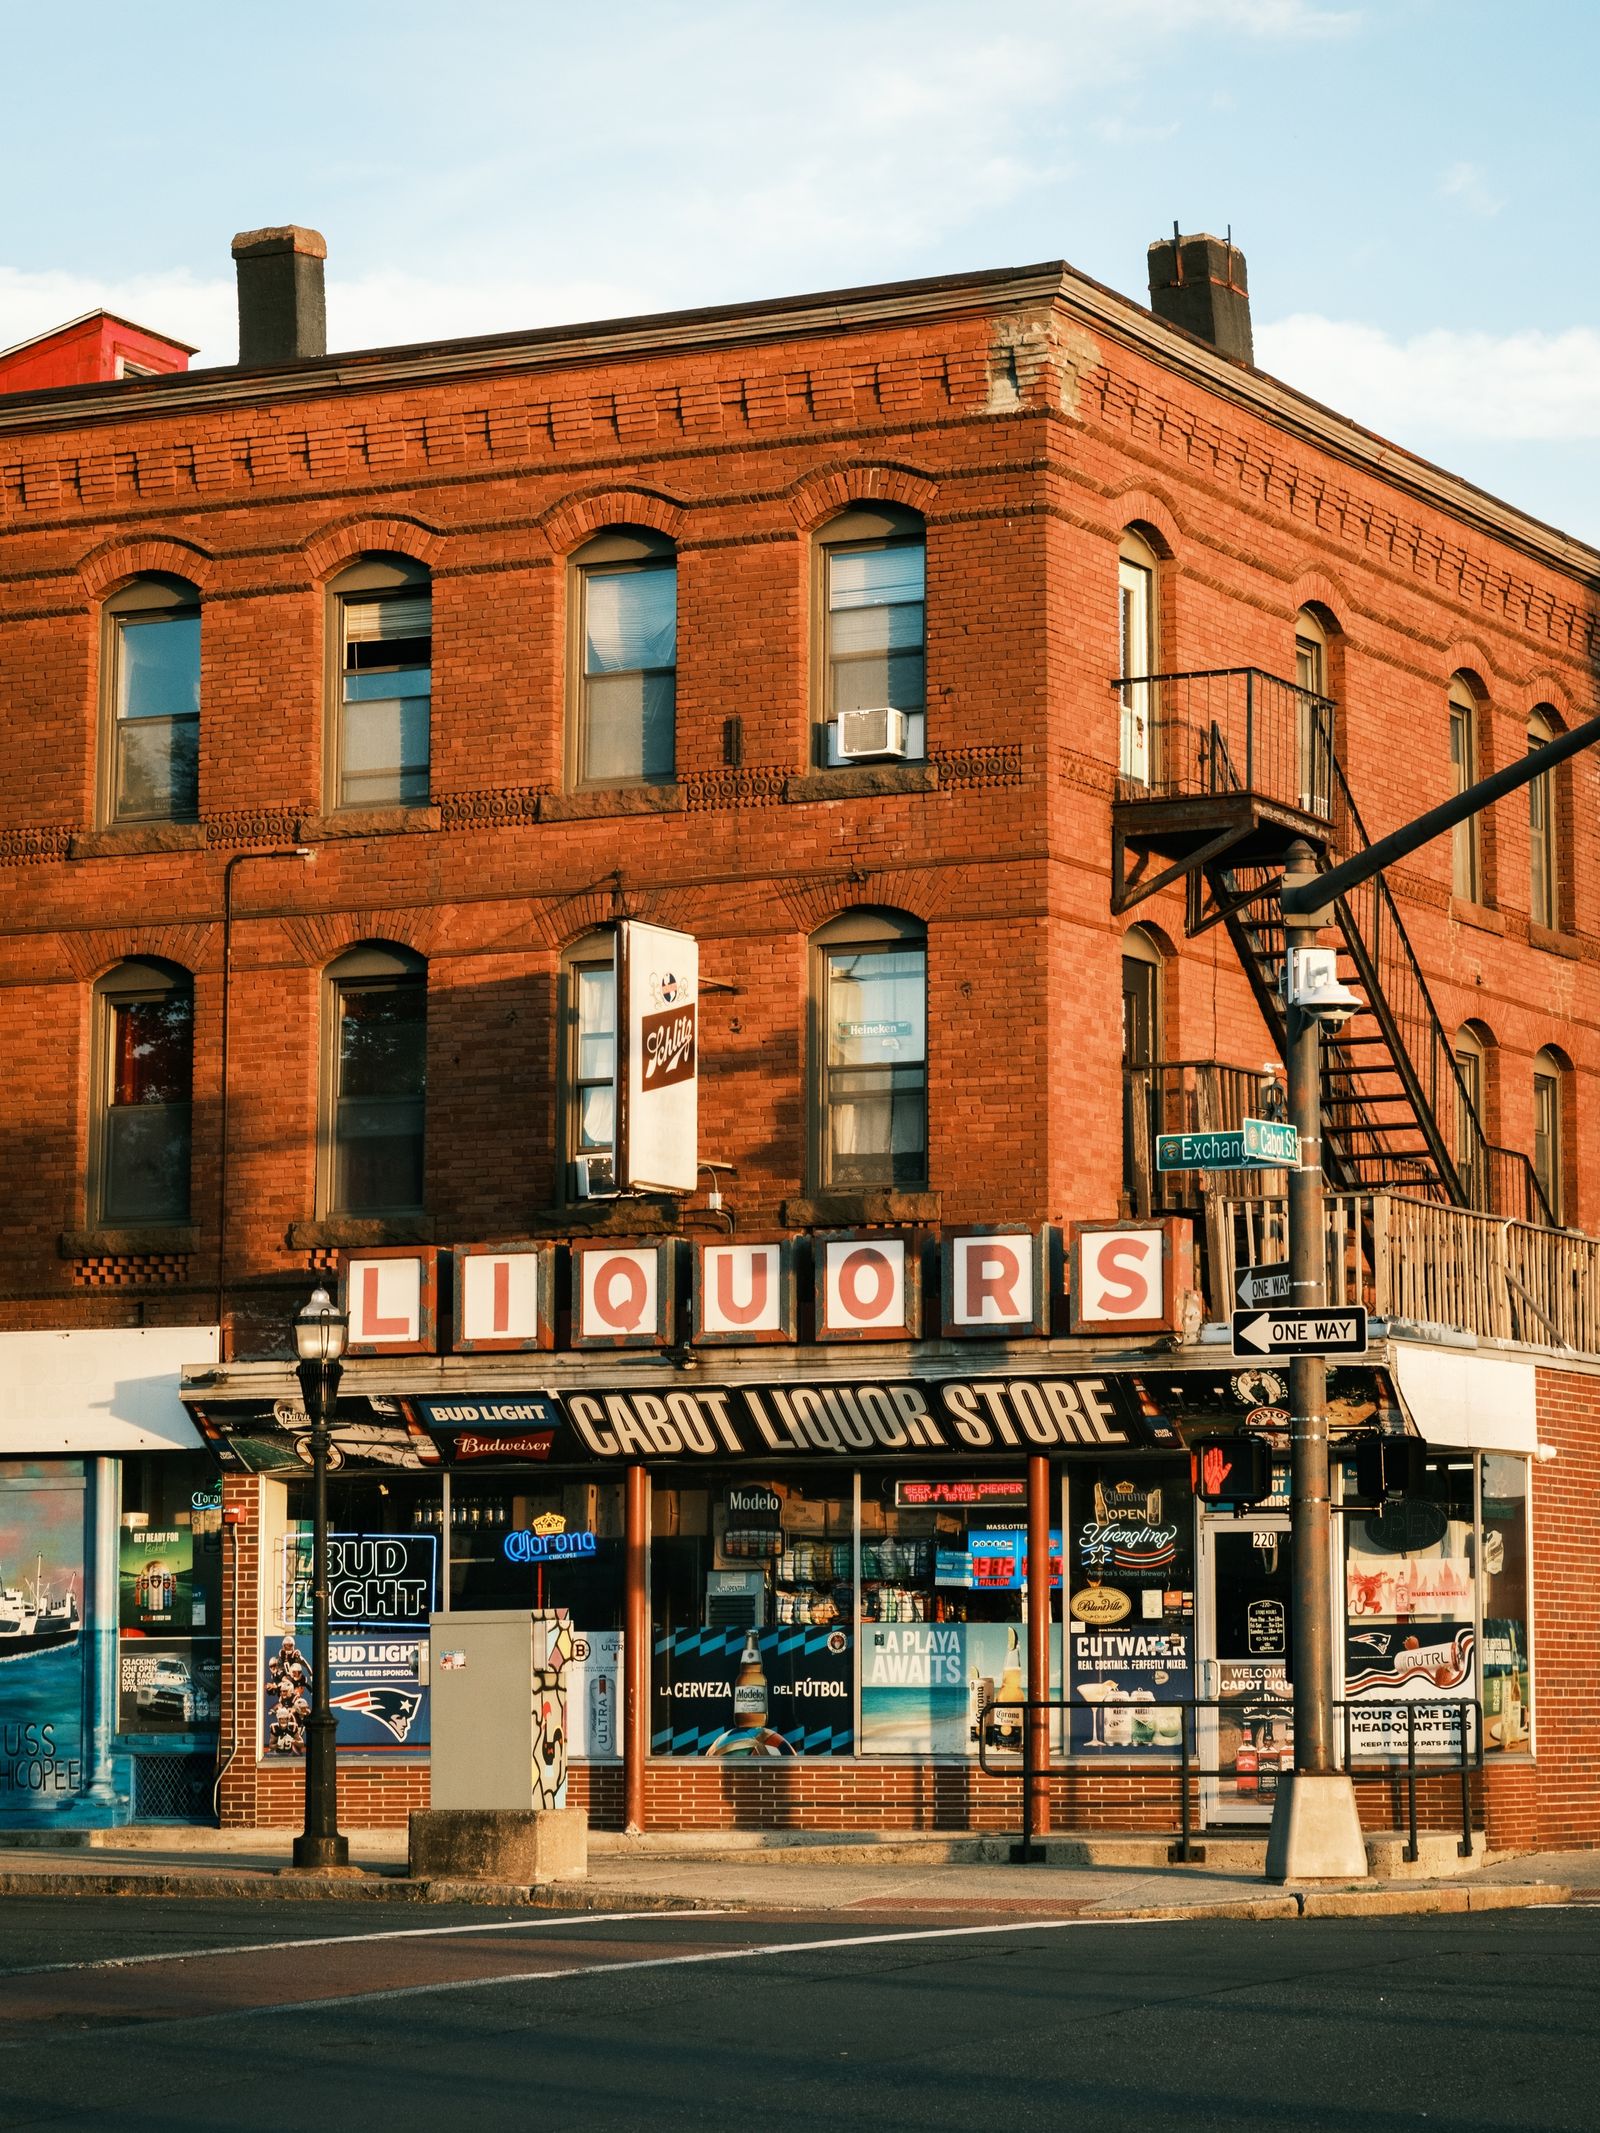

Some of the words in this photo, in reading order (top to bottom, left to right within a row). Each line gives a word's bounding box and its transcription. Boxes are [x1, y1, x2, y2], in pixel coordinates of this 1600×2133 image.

[850, 1024, 897, 1034] Heineken
[645, 1016, 692, 1079] Schlitz
[1260, 1125, 1284, 1157] Cabot
[1285, 1130, 1296, 1158] St
[362, 1238, 1149, 1336] LIQUORS
[1252, 1279, 1269, 1298] ONE
[1272, 1277, 1289, 1295] WAY
[1272, 1323, 1307, 1341] ONE
[1315, 1322, 1351, 1340] WAY
[1230, 1376, 1249, 1405] BOSTON
[1266, 1370, 1288, 1398] CELTICS
[430, 1406, 480, 1421] BUD
[479, 1405, 546, 1420] LIGHT
[568, 1391, 745, 1456] CABOT
[741, 1385, 949, 1453] LIQUOR
[940, 1379, 1129, 1446] STORE
[453, 1438, 551, 1453] Budweiser
[904, 1484, 931, 1494] BEER
[936, 1484, 949, 1494] IS
[954, 1484, 974, 1494] NOW
[979, 1483, 1023, 1494] CHEAPER
[730, 1492, 779, 1511] Modelo
[1105, 1491, 1147, 1505] Corona
[1108, 1509, 1146, 1520] OPEN
[133, 1533, 145, 1542] GET
[146, 1532, 166, 1542] READY
[166, 1532, 179, 1542] FOR
[1079, 1523, 1177, 1549] Yuengling
[1254, 1533, 1275, 1547] 220
[504, 1530, 596, 1562] Corona
[312, 1540, 407, 1577] BUD
[549, 1552, 577, 1560] CHICOPEE
[1119, 1569, 1140, 1577] Oldest
[1140, 1569, 1167, 1578] Brewery
[979, 1578, 1010, 1586] MILLION
[293, 1580, 426, 1617] LGHT
[903, 1630, 961, 1654] PLAYA
[329, 1646, 366, 1663] BUD
[368, 1645, 418, 1663] LIGH
[576, 1645, 585, 1657] B
[122, 1658, 157, 1666] CRACKING
[871, 1655, 961, 1684] AWAITS
[1077, 1661, 1093, 1670] REAL
[1095, 1660, 1130, 1670] COCKTAILS.
[1131, 1660, 1165, 1670] PERFECTLY
[1167, 1660, 1188, 1670] MIXED.
[660, 1686, 682, 1696] LA
[684, 1682, 732, 1698] CERVEZA
[773, 1686, 803, 1695] DEL
[805, 1677, 848, 1697] FÚTBOL
[1221, 1681, 1262, 1690] CABOT
[738, 1689, 765, 1700] Modelo
[598, 1699, 608, 1744] ULTRA
[996, 1710, 1020, 1719] Corona
[1352, 1710, 1392, 1720] YOUR
[1352, 1721, 1472, 1733] HEADQUARTERS
